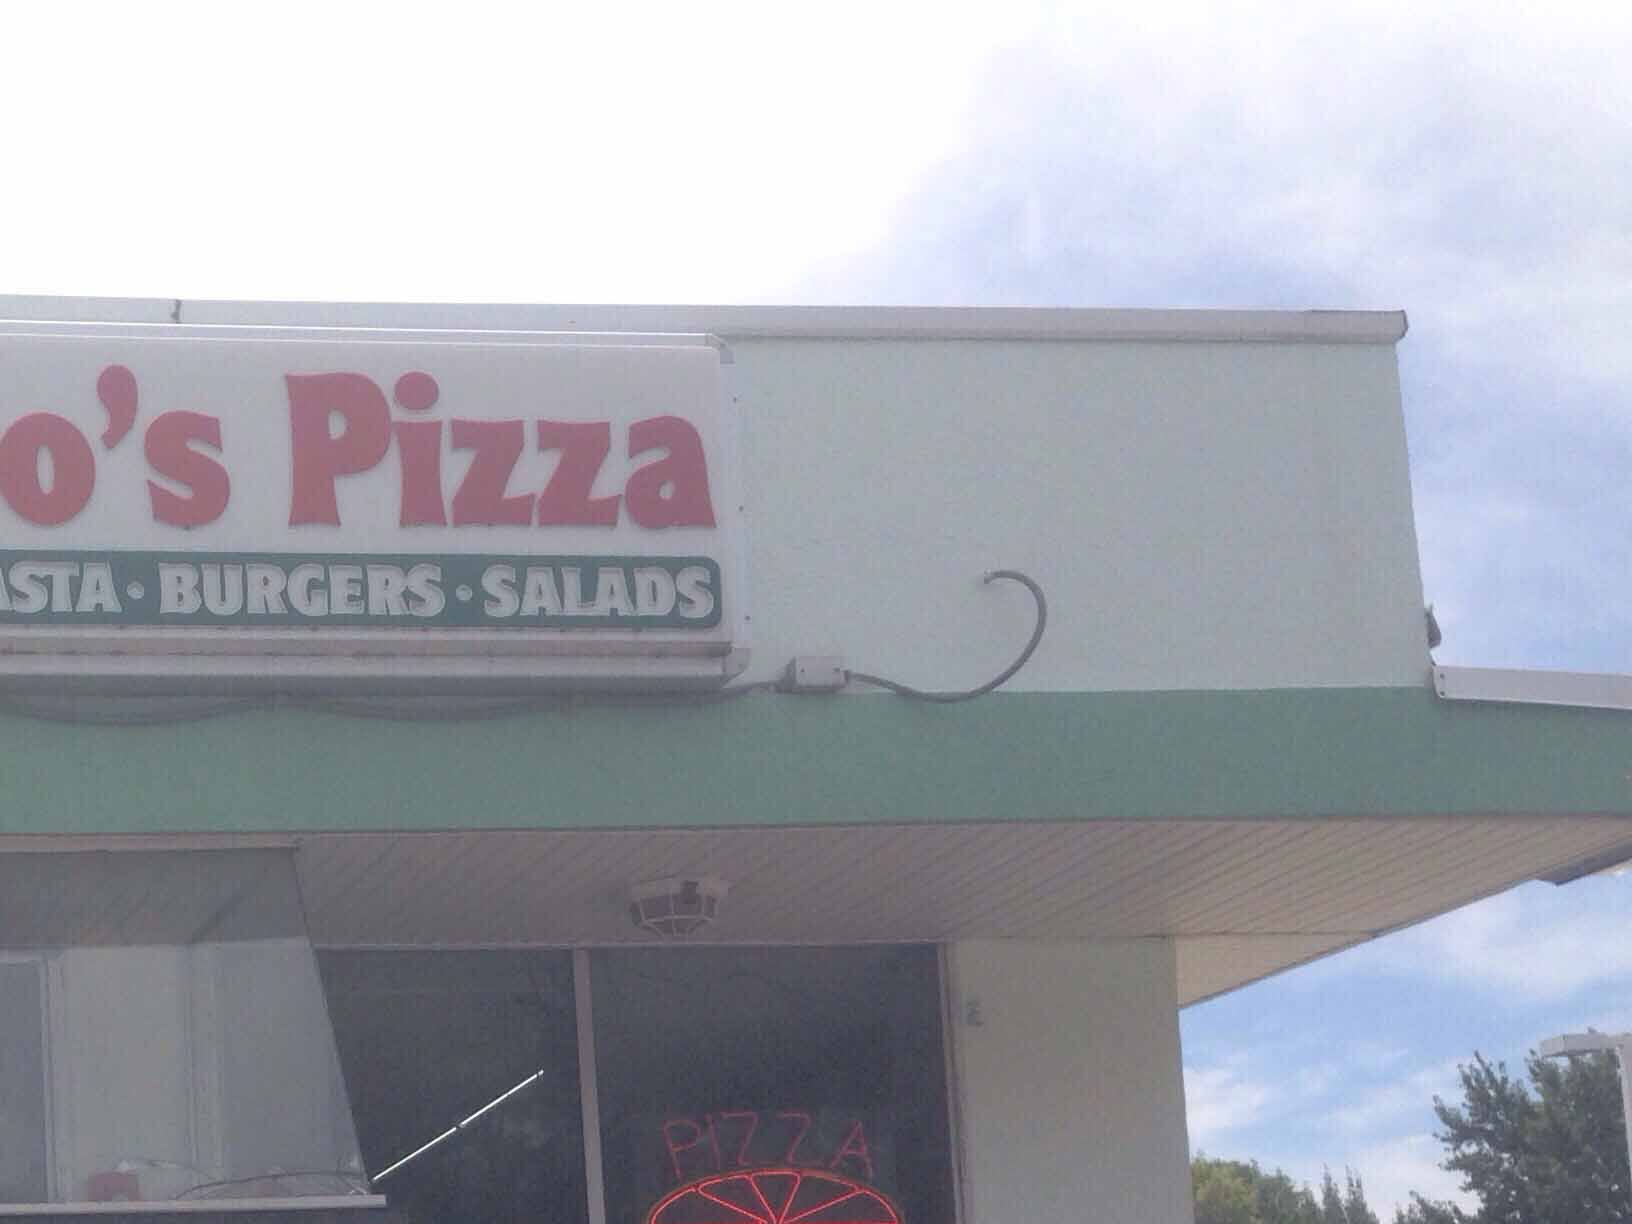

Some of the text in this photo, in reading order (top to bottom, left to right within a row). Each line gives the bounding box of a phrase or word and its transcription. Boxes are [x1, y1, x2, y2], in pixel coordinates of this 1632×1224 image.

[283, 369, 718, 531] Pizza
[158, 561, 447, 618] BURGERS
[480, 565, 716, 620] SALADS
[662, 1109, 874, 1184] PIZZA
